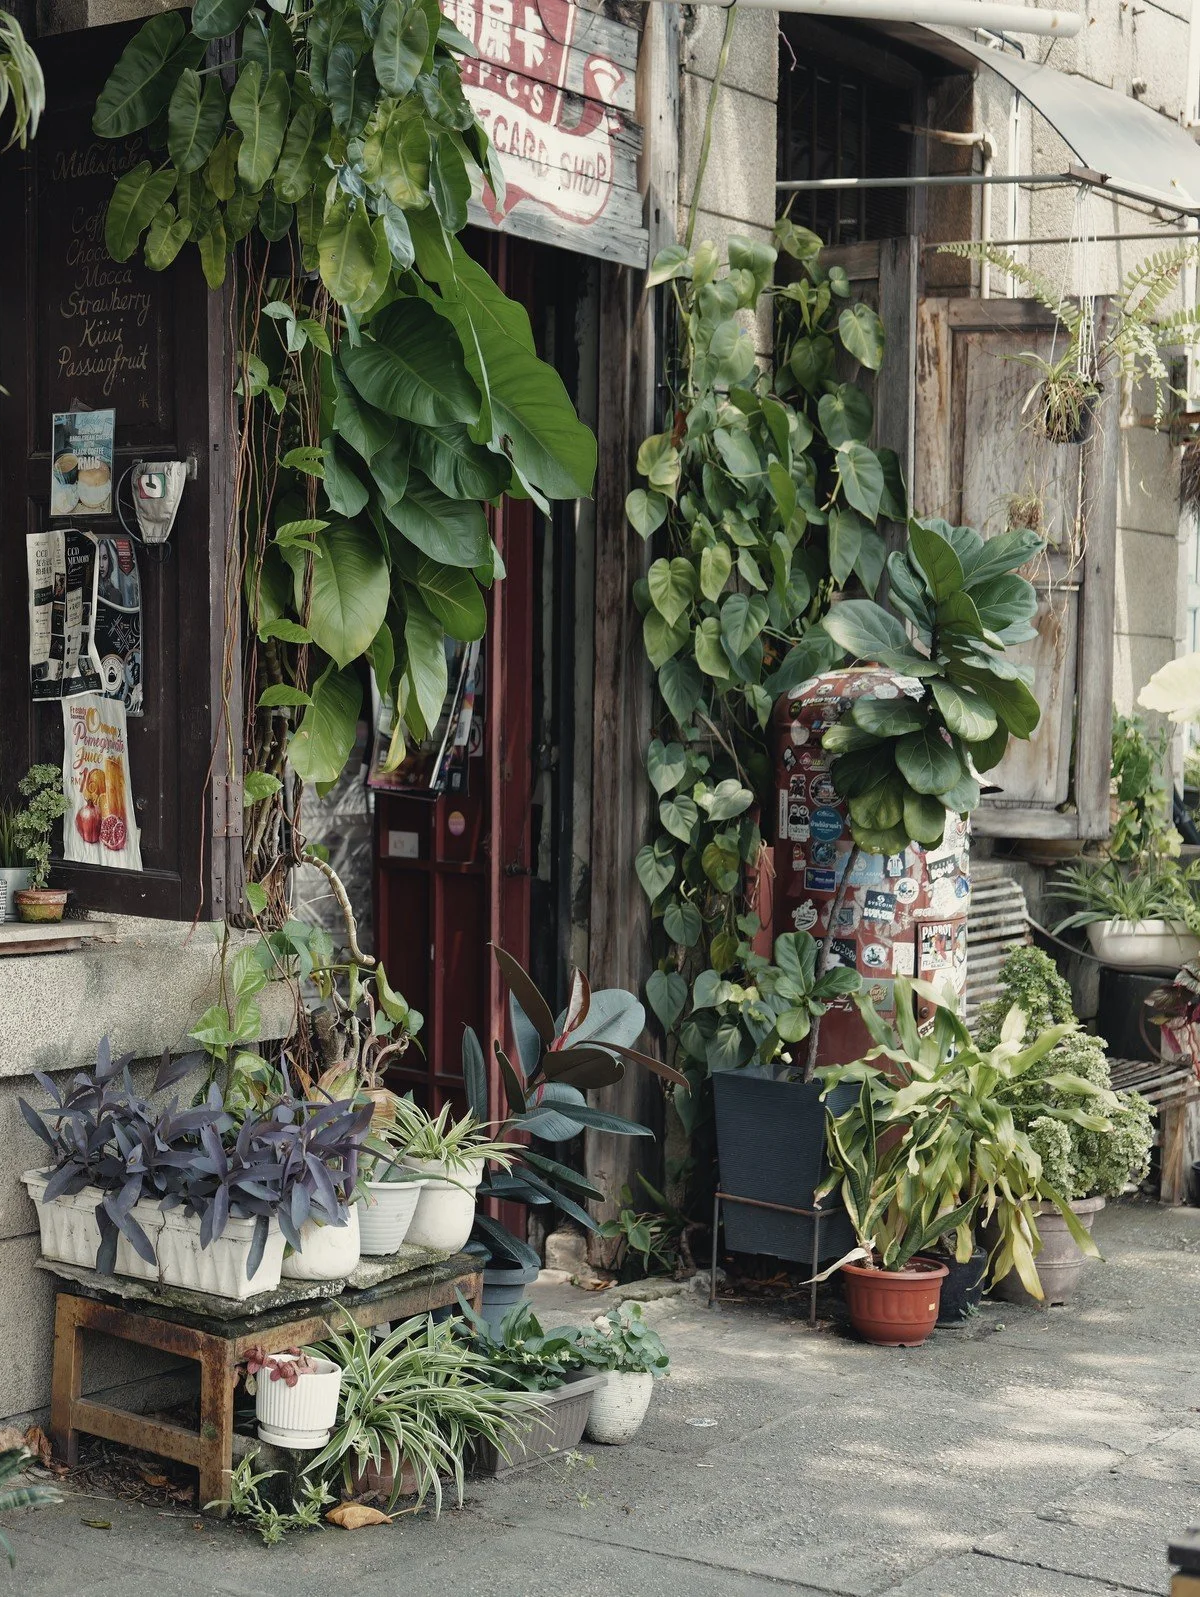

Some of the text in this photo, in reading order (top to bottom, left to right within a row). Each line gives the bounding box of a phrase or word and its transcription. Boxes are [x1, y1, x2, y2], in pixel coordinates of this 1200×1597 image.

[477, 105, 607, 197] CARD SHOP
[72, 200, 107, 243] Coff
[75, 266, 133, 291] Mocca
[60, 288, 151, 326] Strawberry
[79, 318, 124, 348] Kiwi
[57, 344, 149, 396] Passionfruit
[67, 547, 79, 557] CCD
[72, 746, 104, 769] Juice
[921, 923, 952, 941] PARROT
